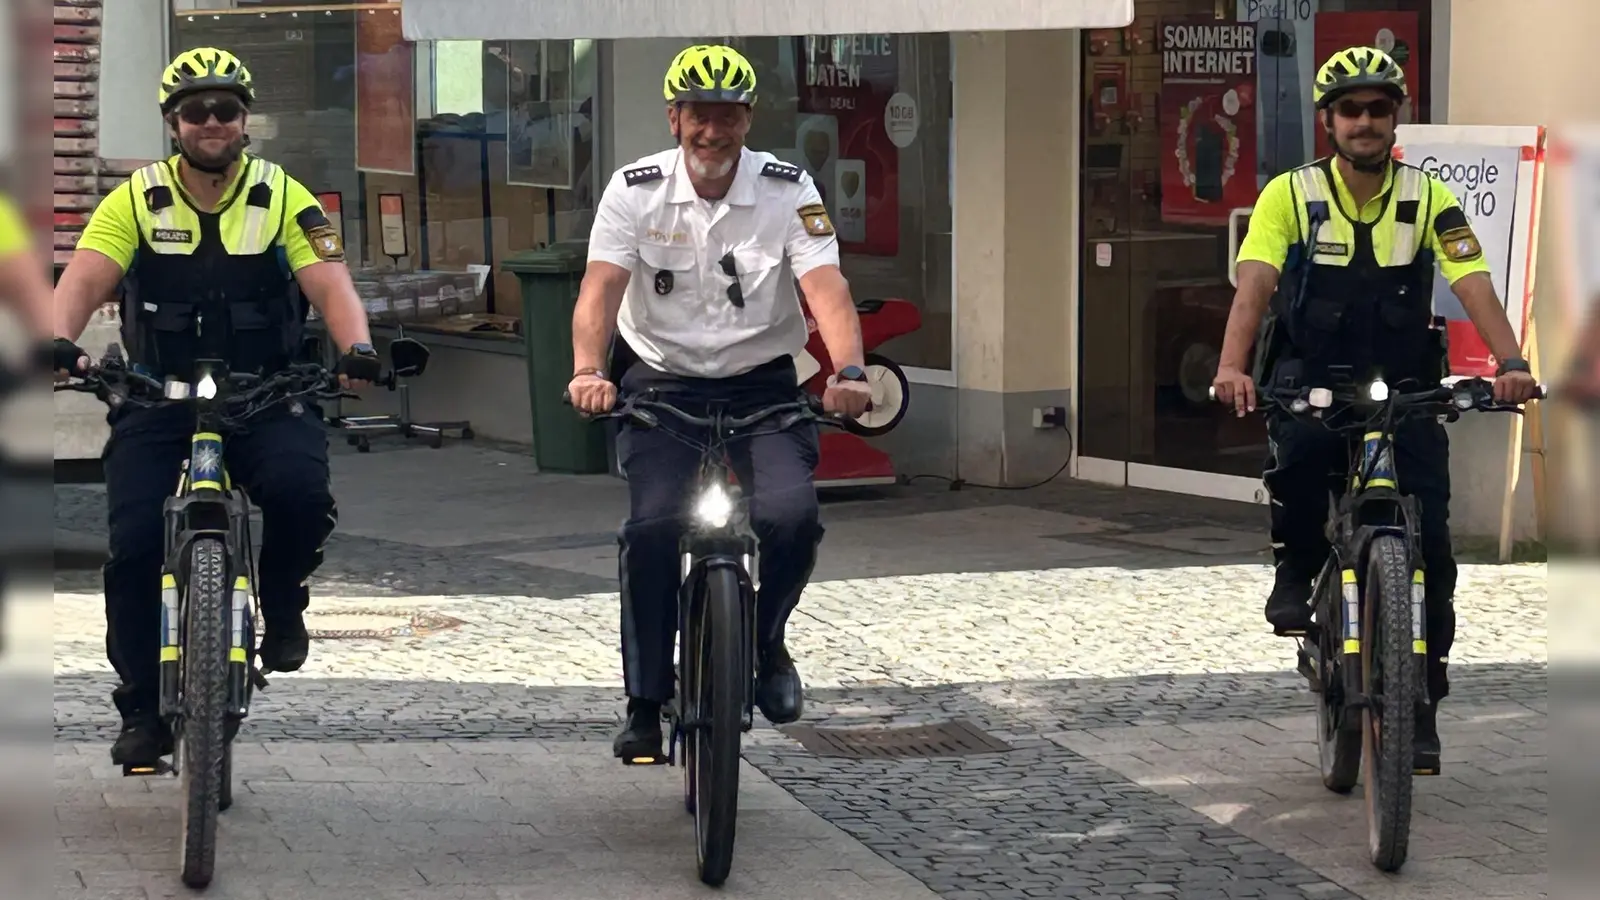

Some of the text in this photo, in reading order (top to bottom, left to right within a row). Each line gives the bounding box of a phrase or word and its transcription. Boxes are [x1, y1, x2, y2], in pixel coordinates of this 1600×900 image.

[1248, 0, 1311, 20] Pixel 10
[1164, 25, 1255, 49] SOMMEHR
[1164, 51, 1254, 74] INTERNET
[806, 64, 860, 87] DATEN
[1420, 156, 1499, 190] Google
[1473, 191, 1496, 216] 10
